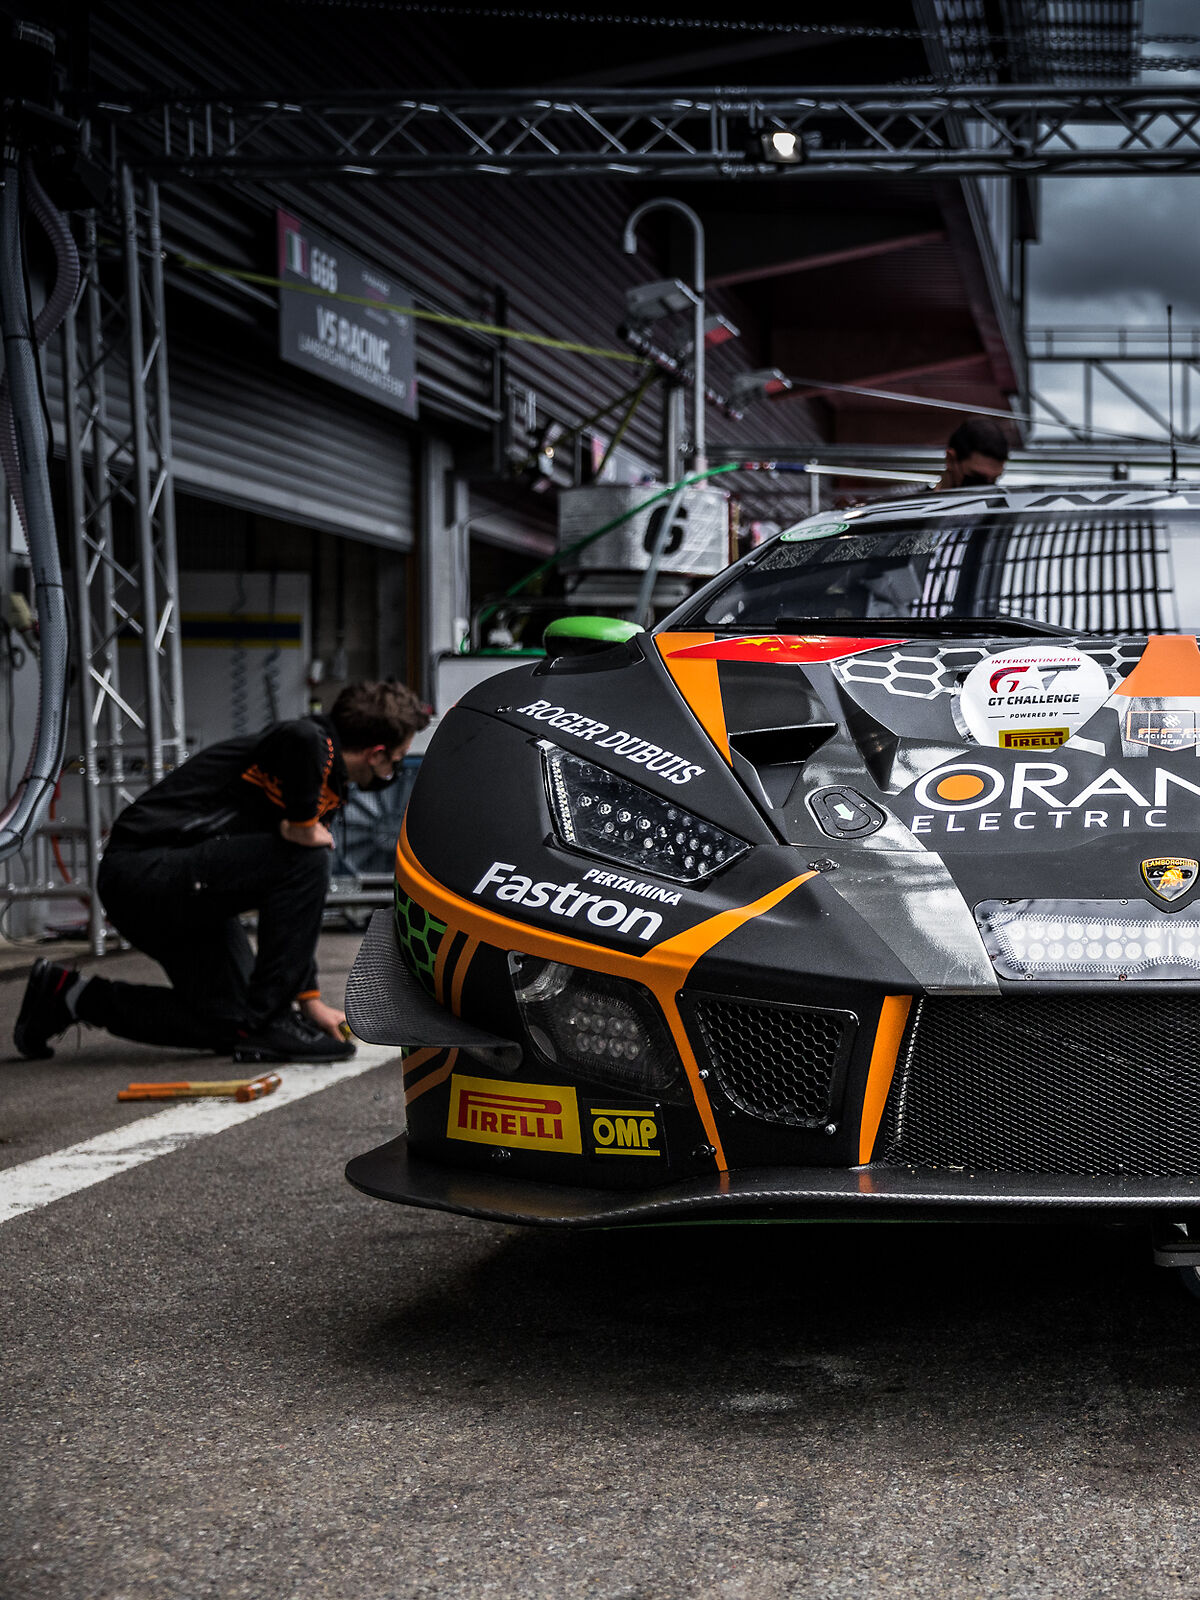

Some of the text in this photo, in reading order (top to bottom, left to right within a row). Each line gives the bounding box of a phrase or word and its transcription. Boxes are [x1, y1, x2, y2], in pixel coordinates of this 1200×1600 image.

[311, 246, 338, 294] 666
[316, 304, 338, 347] VS
[338, 317, 390, 374] RACING
[991, 657, 1081, 665] INTERCONTINENTAL
[988, 694, 1080, 706] GT CHALLENGE
[1010, 711, 1047, 719] POWERED
[517, 700, 706, 785] ROGER DUBUIS
[1004, 731, 1064, 748] PIRELLI
[911, 809, 1168, 834] ELECTRIC
[472, 861, 663, 941] Fastron
[582, 868, 683, 906] PERTAMINA
[457, 1088, 564, 1140] PIRELLI
[592, 1117, 658, 1147] OMP
